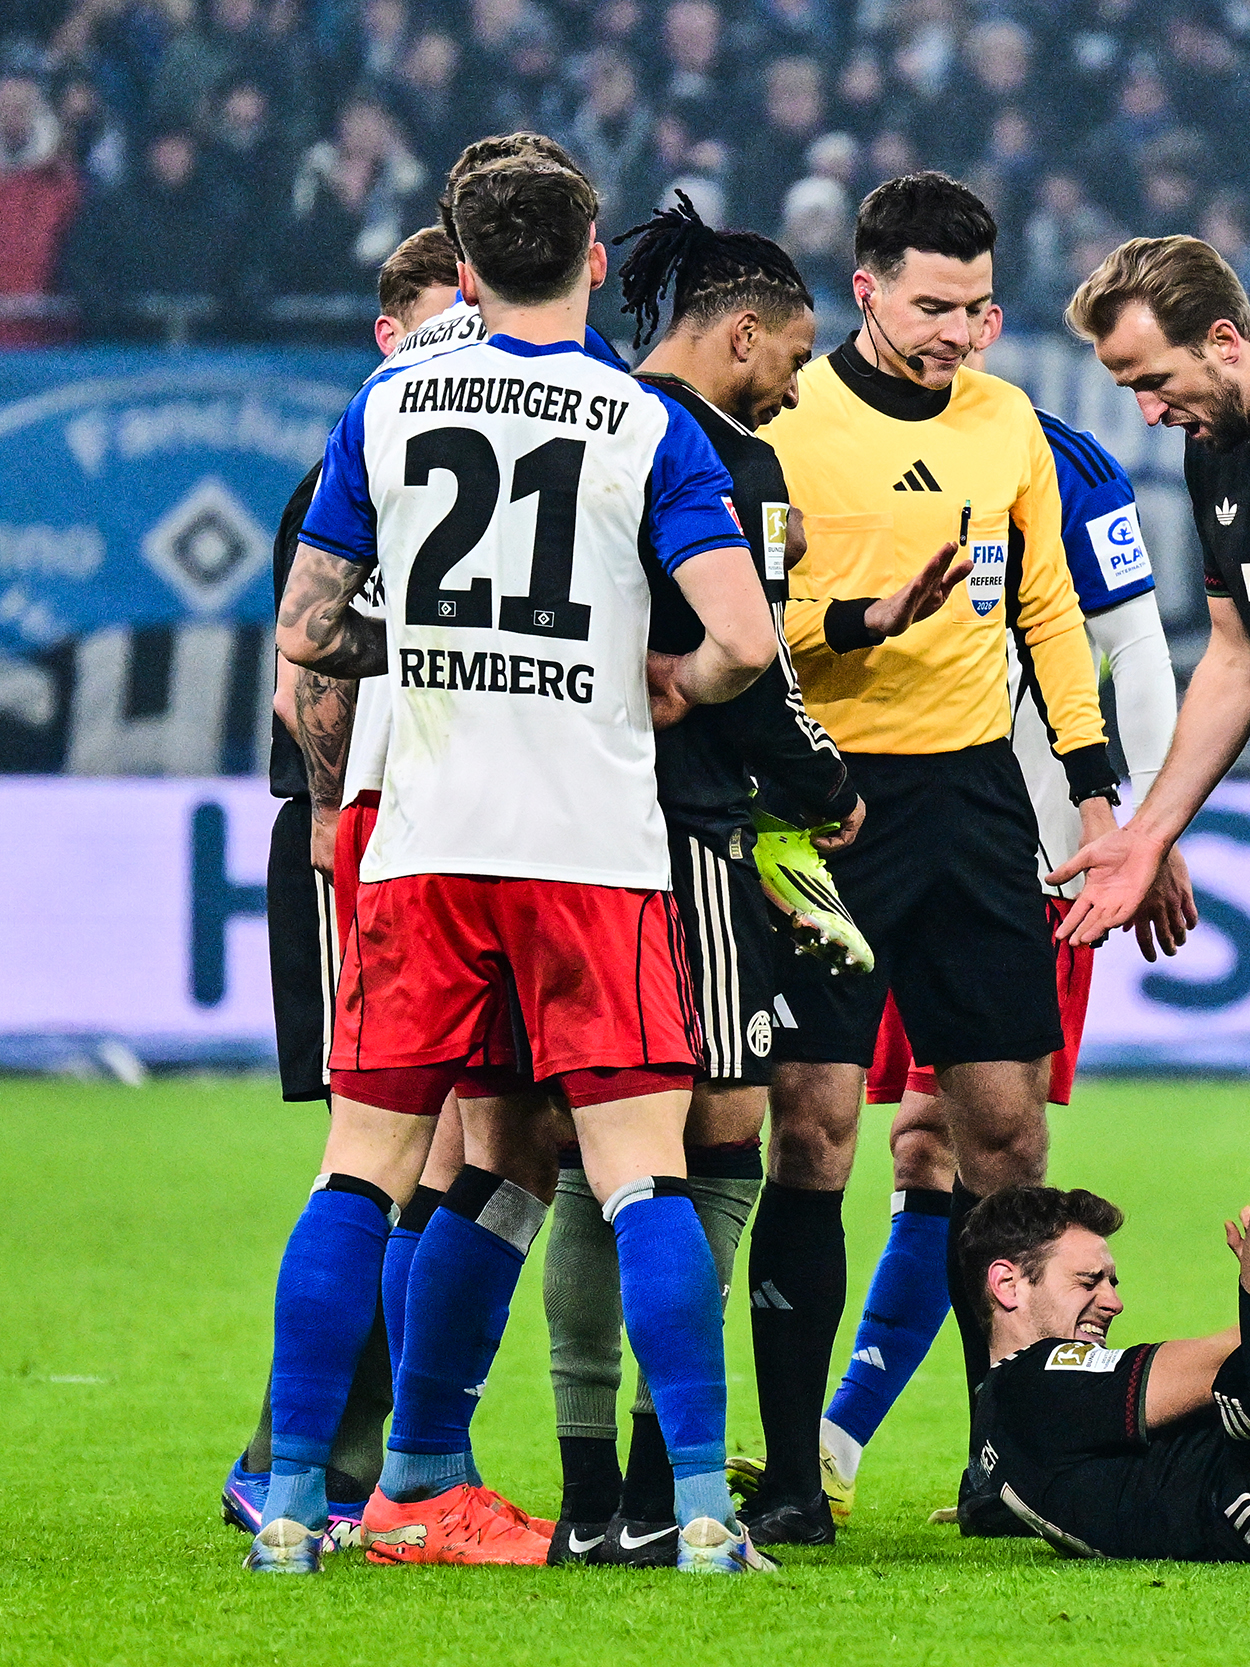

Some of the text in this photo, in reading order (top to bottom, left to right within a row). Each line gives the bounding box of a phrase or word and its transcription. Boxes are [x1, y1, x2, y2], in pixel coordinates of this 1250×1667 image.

[399, 377, 630, 436] HAMBURGER SV
[403, 426, 592, 642] 21
[972, 545, 1005, 564] FIFA
[969, 575, 1003, 587] REFEREE
[976, 601, 993, 611] 2026
[399, 648, 595, 704] REMBERG
